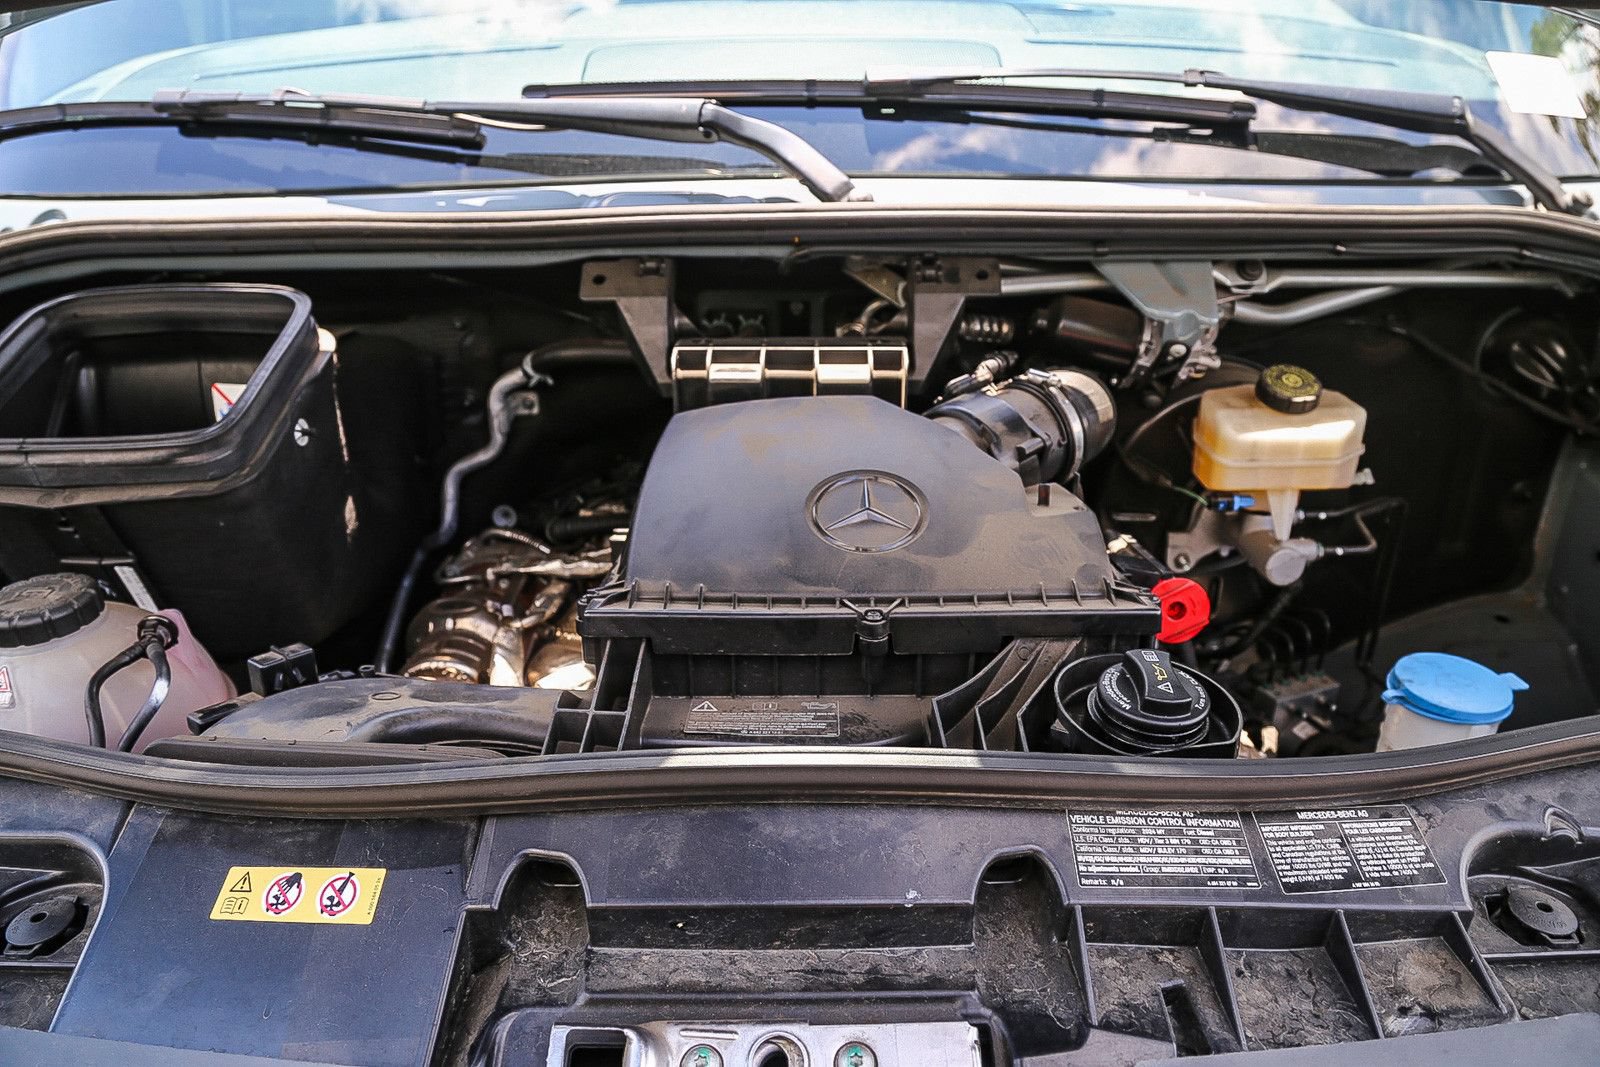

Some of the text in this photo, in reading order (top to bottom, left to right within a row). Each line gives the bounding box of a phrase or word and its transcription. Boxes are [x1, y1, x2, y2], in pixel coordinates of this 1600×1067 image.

[1296, 808, 1369, 820] MERCEDES-BENZ AG
[1069, 814, 1240, 829] VEHICLE EMISSION CONTROL INFORMATION
[1072, 826, 1099, 834] Conforms
[1197, 829, 1215, 837] Diesel
[1086, 835, 1099, 843] EPA
[1074, 845, 1103, 854] California
[1176, 847, 1187, 855] 170
[1081, 877, 1125, 887] Remarks: n/a
